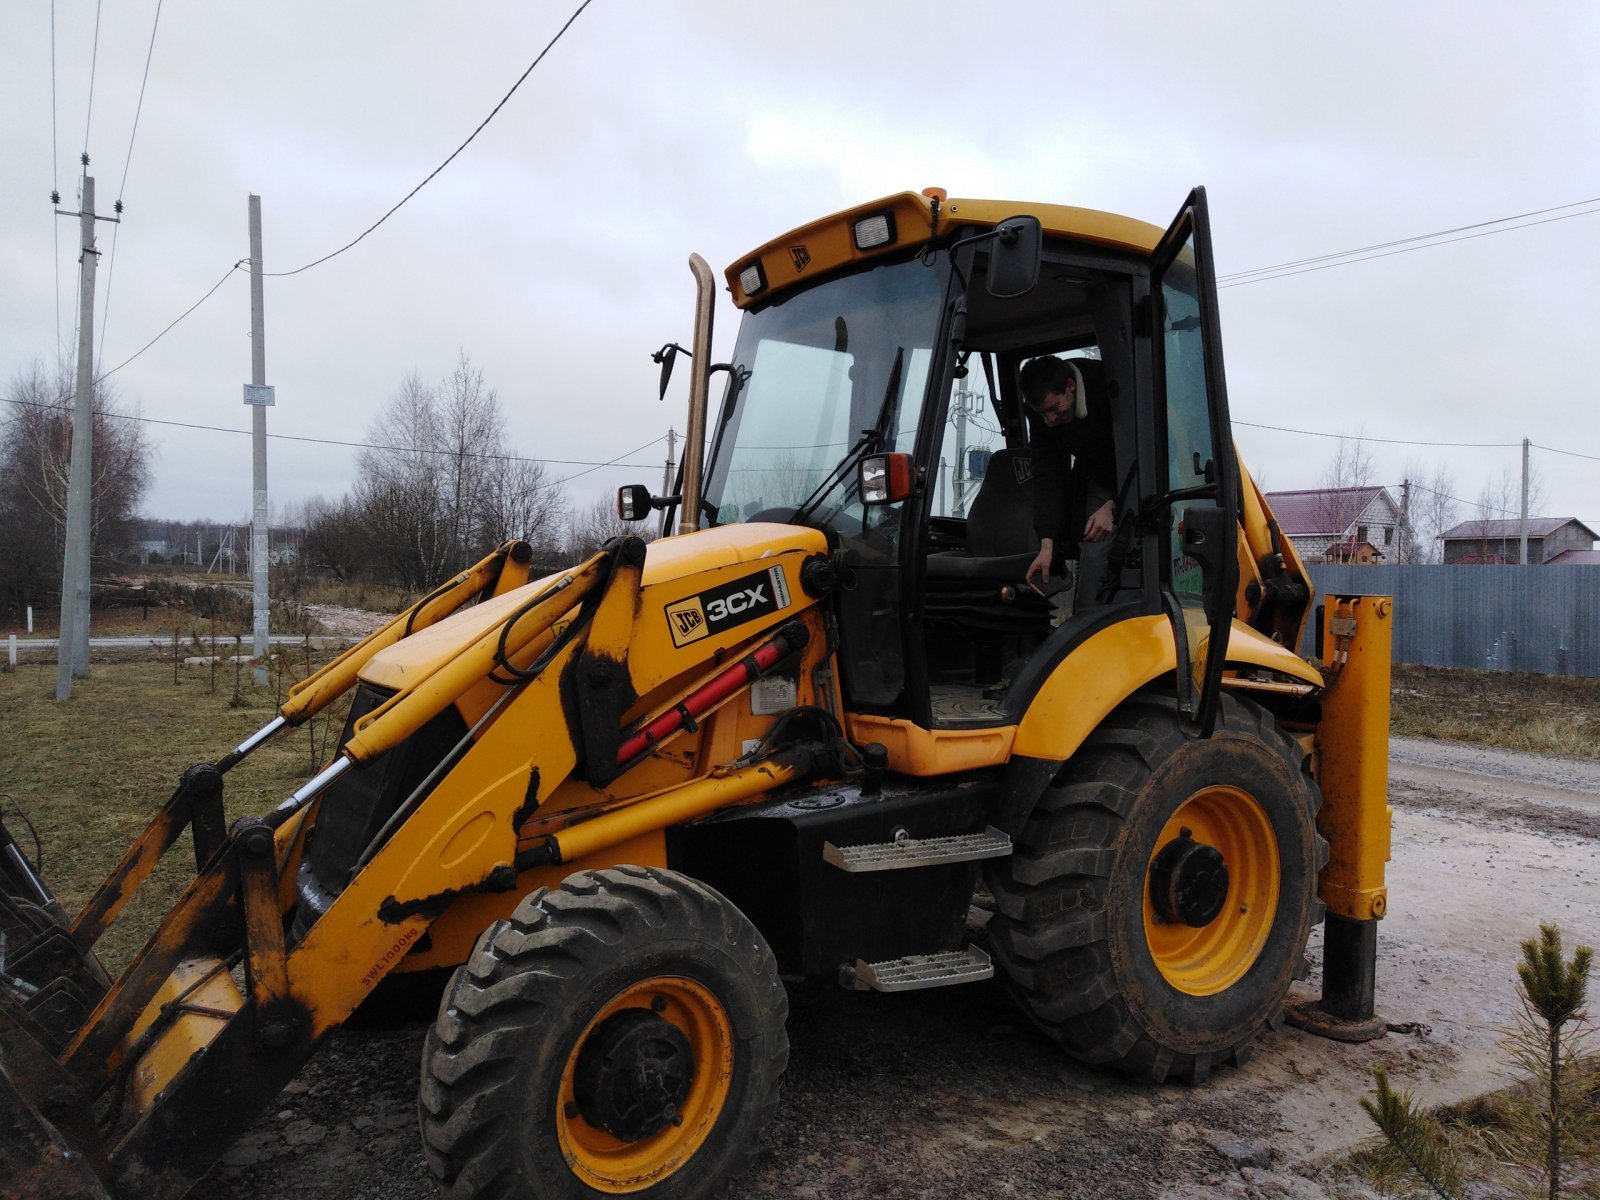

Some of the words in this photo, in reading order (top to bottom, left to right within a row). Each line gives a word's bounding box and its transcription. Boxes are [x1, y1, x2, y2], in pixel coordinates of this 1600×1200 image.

[791, 248, 809, 270] JCB
[706, 584, 769, 622] 3CX
[677, 610, 701, 634] JCB
[362, 964, 385, 986] SWL
[382, 928, 418, 963] 1000kg
